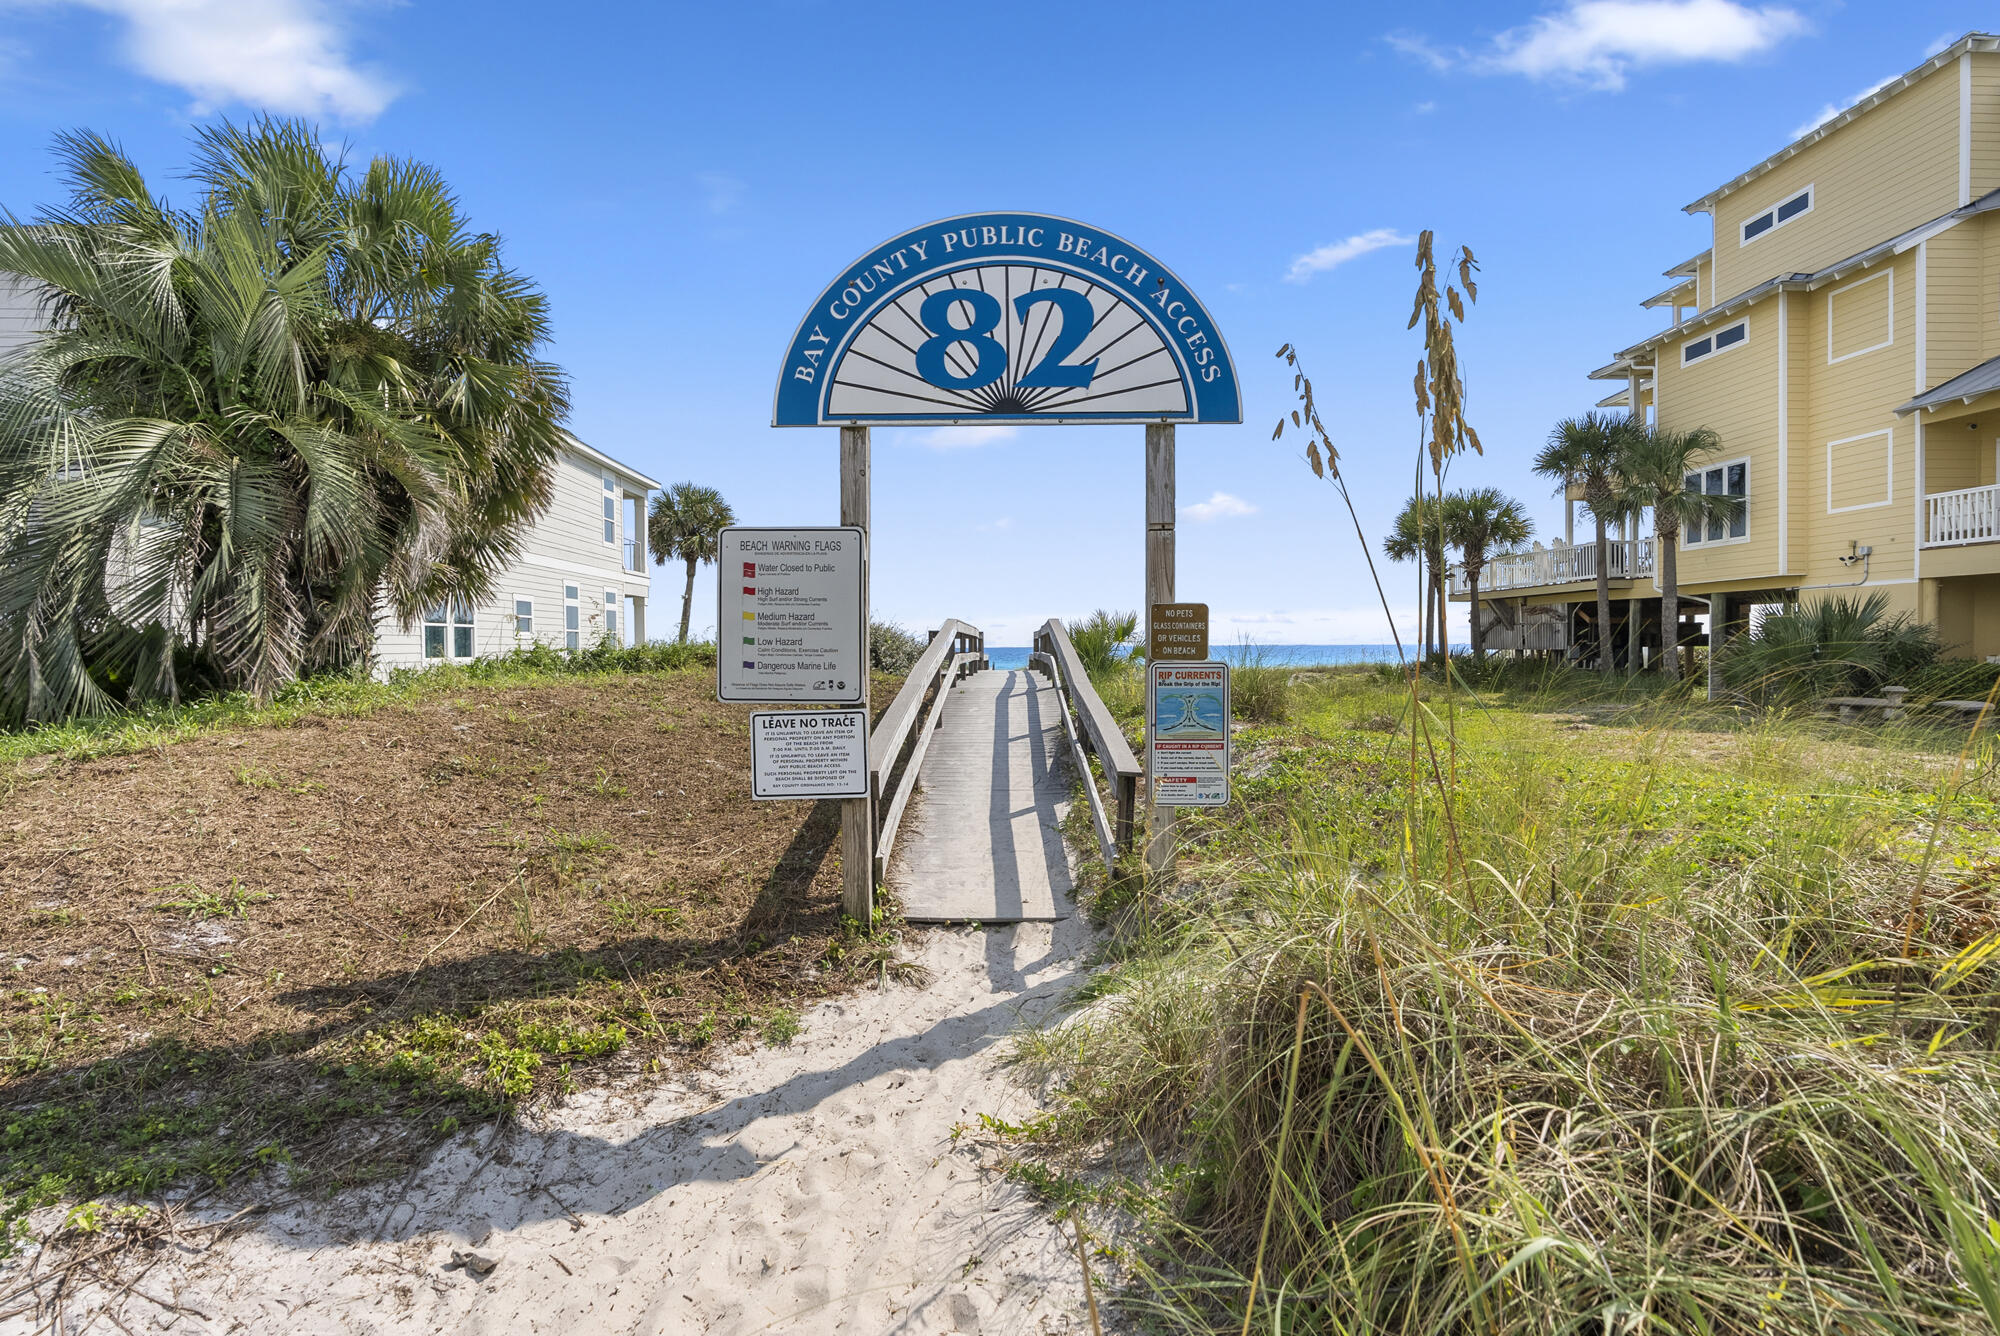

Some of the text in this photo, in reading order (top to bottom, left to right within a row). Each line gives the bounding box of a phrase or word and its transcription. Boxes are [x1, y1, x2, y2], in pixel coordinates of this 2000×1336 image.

[794, 226, 1221, 384] BAY COUNTY PUBLIC BEACH ACCESS
[916, 288, 1100, 390] 82
[740, 540, 841, 551] BEACH WARNING FLAGS
[758, 564, 835, 572] Water Closed to Public
[758, 587, 799, 597] High Hazard
[758, 637, 802, 645] Low Hazard
[758, 662, 836, 671] Dangerous Marine Life
[1158, 672, 1222, 680] RIP CURRENTS
[763, 717, 855, 729] LEAVE NO TRACE
